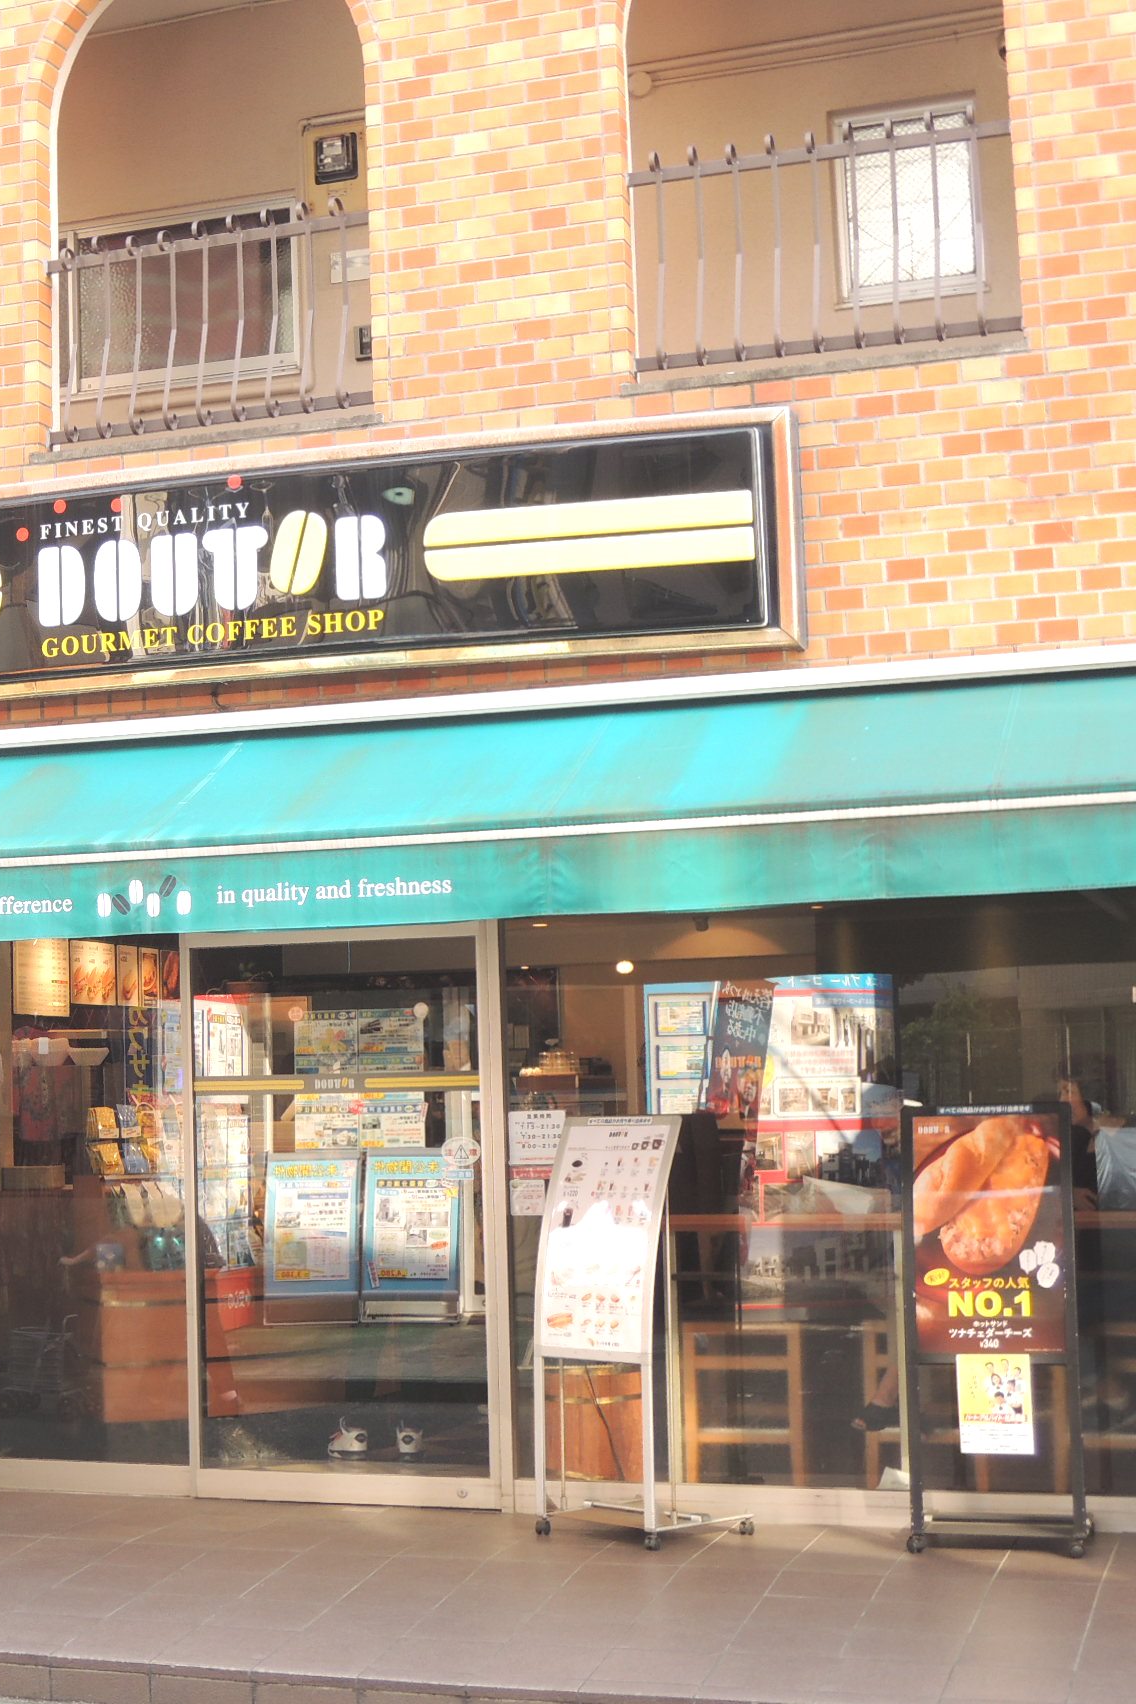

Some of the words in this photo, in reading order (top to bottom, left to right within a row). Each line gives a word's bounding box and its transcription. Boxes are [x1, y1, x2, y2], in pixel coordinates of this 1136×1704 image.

[39, 514, 123, 540] FINEST
[137, 502, 251, 532] QUALITY
[38, 510, 387, 628] DOUTOR
[41, 625, 177, 658] GOURMET
[187, 615, 297, 645] COFFEE
[306, 609, 385, 635] SHOP
[216, 885, 236, 904] in
[241, 882, 309, 908] quality
[315, 879, 351, 900] and
[357, 876, 453, 898] freshness
[314, 1077, 355, 1089] DOUTOR
[948, 1276, 1030, 1289] スタッフの人気
[947, 1290, 1032, 1318] NO.1
[948, 1328, 1033, 1339] ツナチェダーチーズ
[972, 1320, 1008, 1328] ホットサンド
